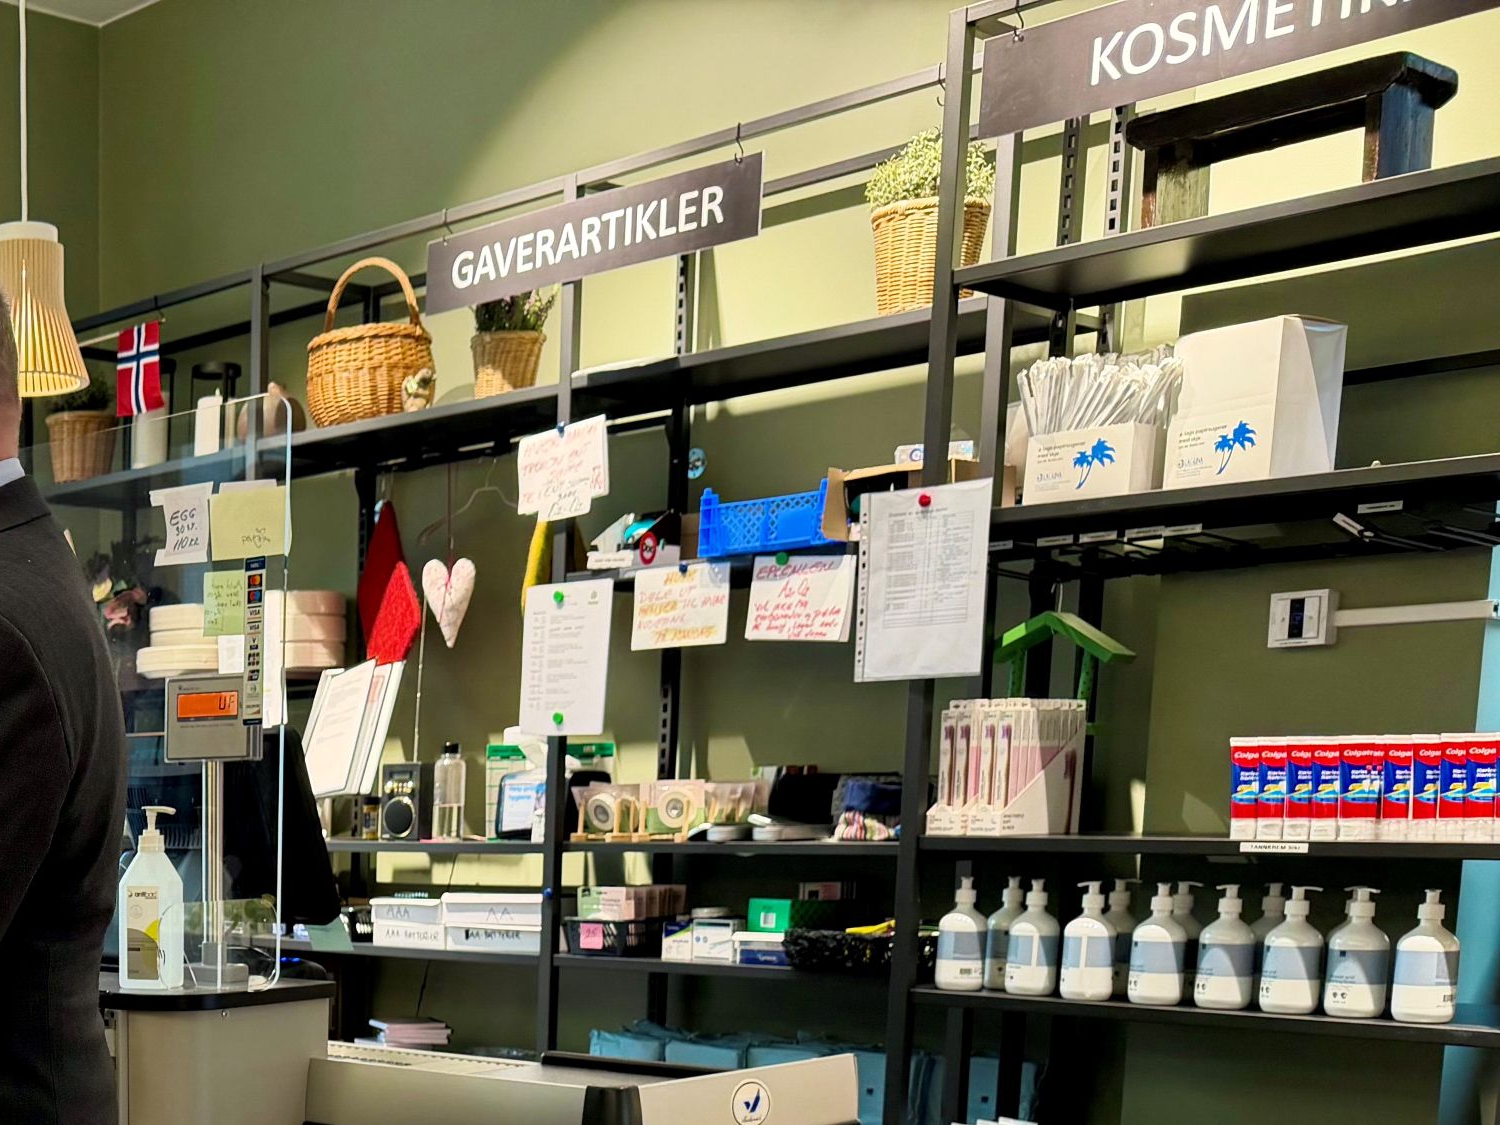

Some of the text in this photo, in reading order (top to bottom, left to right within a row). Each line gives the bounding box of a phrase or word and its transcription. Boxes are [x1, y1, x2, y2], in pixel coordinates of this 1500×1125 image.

[1090, 0, 1411, 86] KOSME
[451, 185, 724, 289] GAVERARTIKLER
[169, 507, 197, 526] EGG
